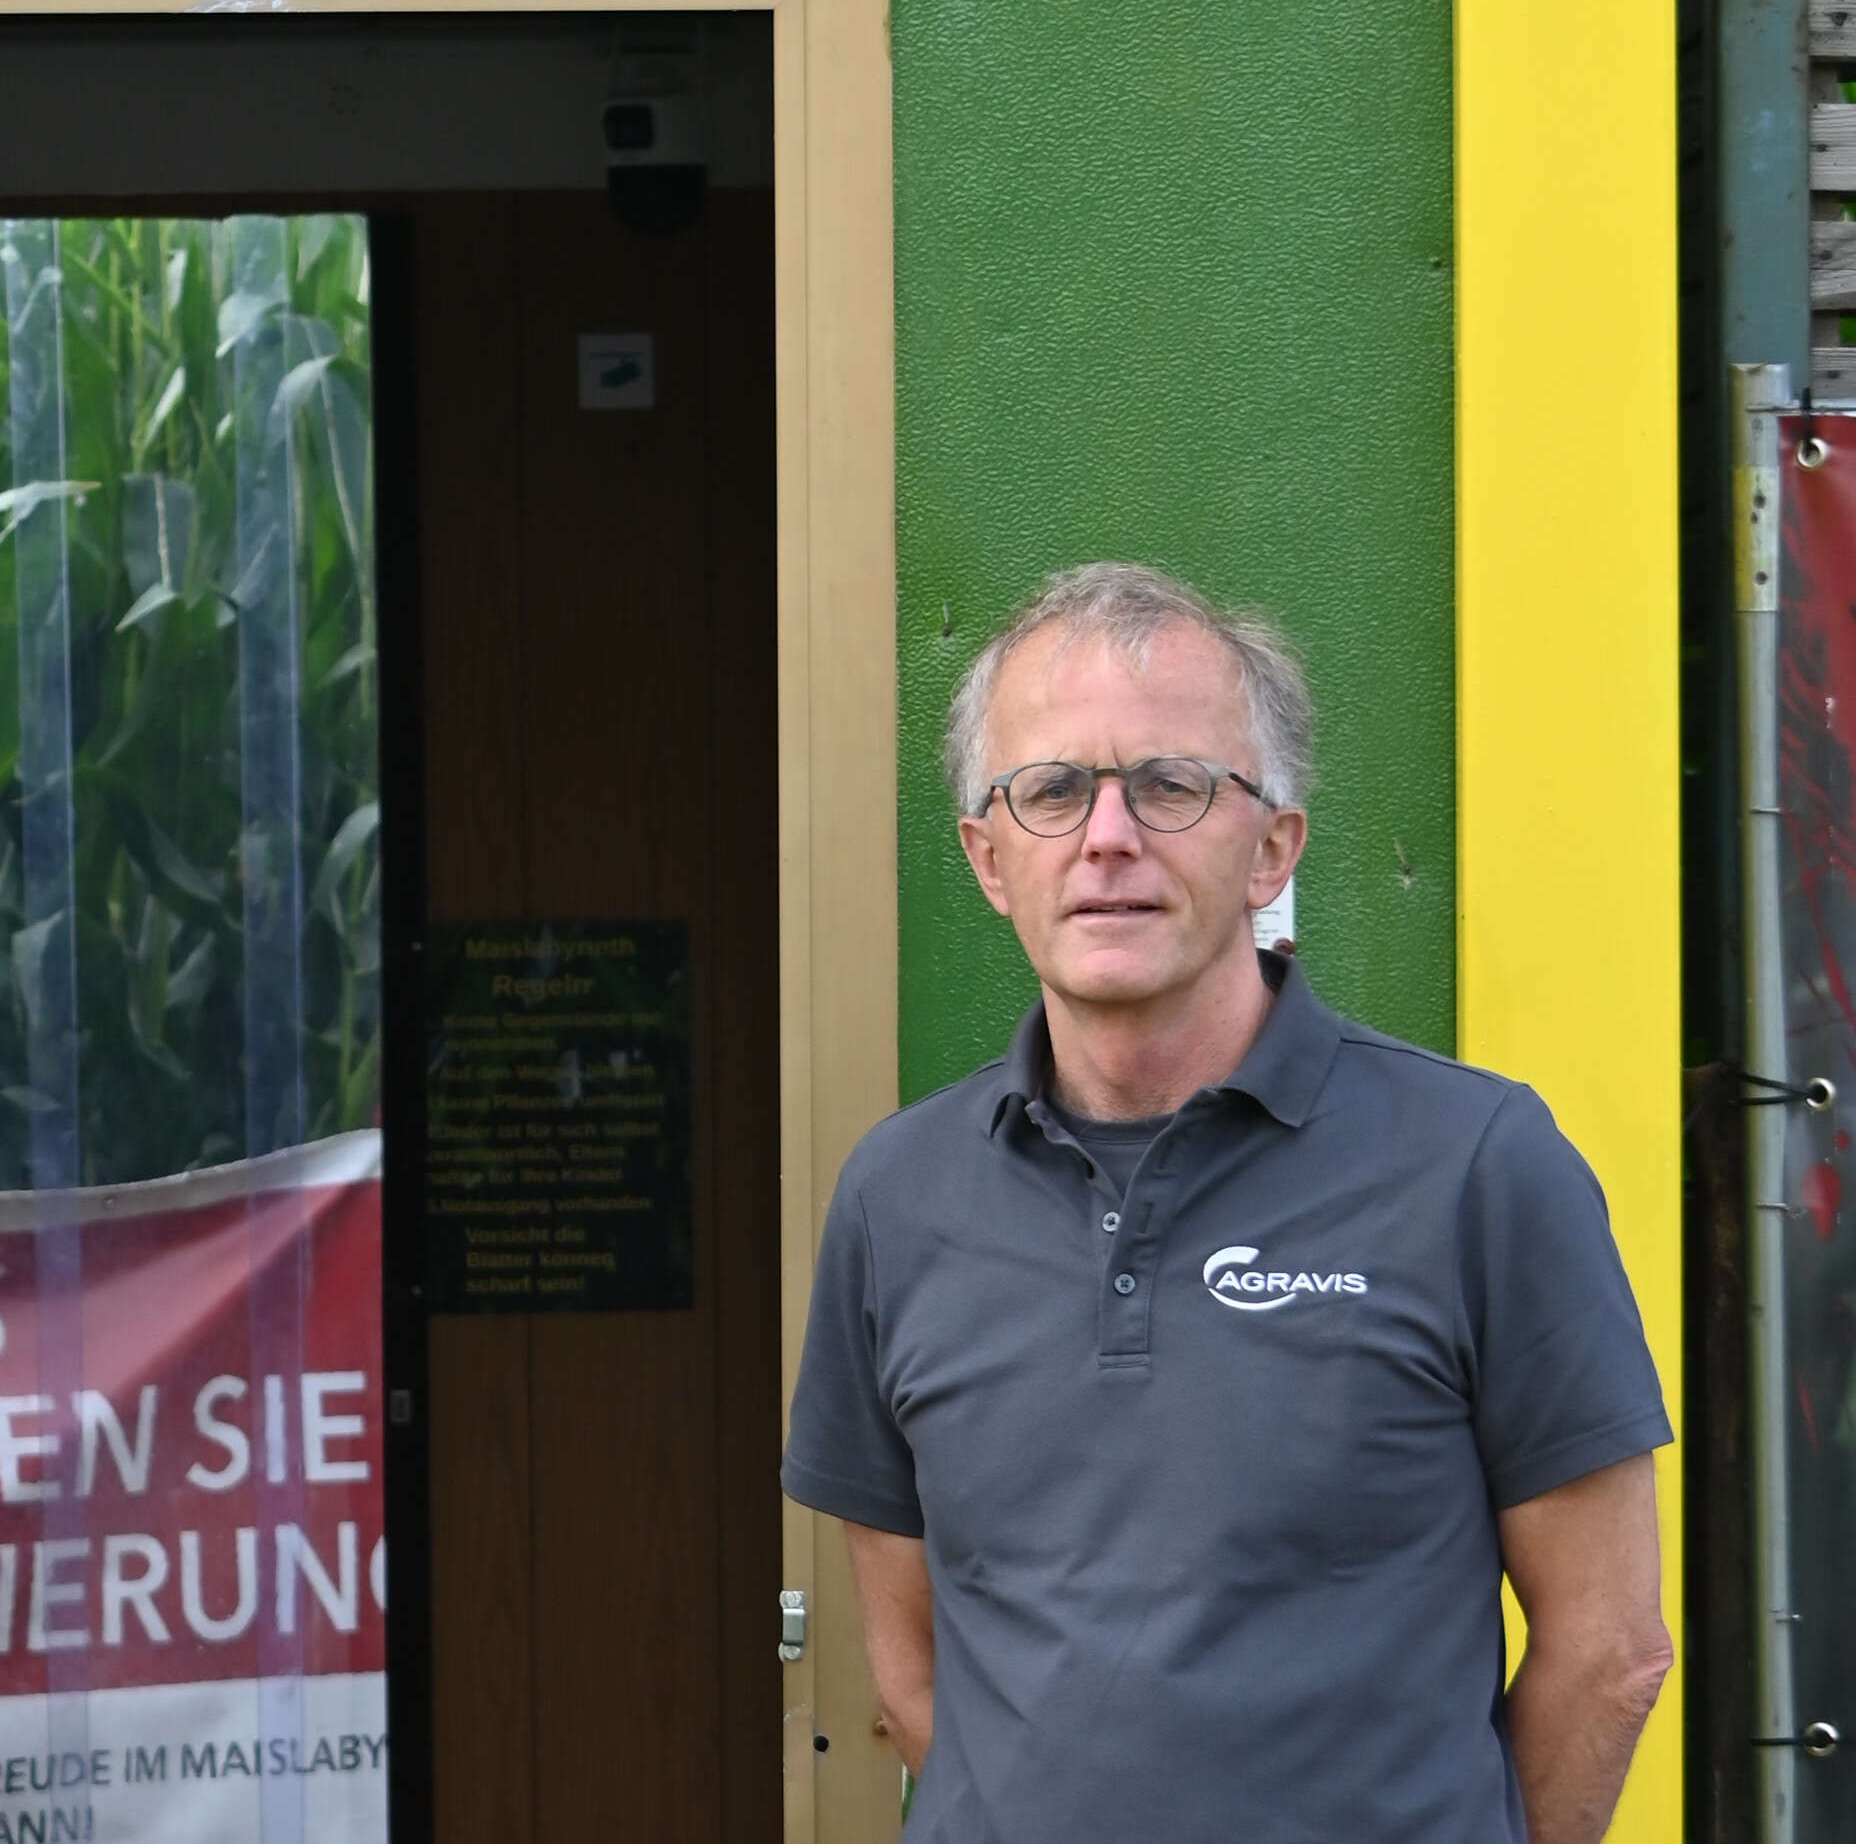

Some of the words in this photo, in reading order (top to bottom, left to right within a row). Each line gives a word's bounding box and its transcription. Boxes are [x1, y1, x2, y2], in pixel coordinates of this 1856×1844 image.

[1215, 1270, 1368, 1294] AGRAVIS
[187, 1371, 369, 1491] SIE
[123, 1746, 167, 1784] IM
